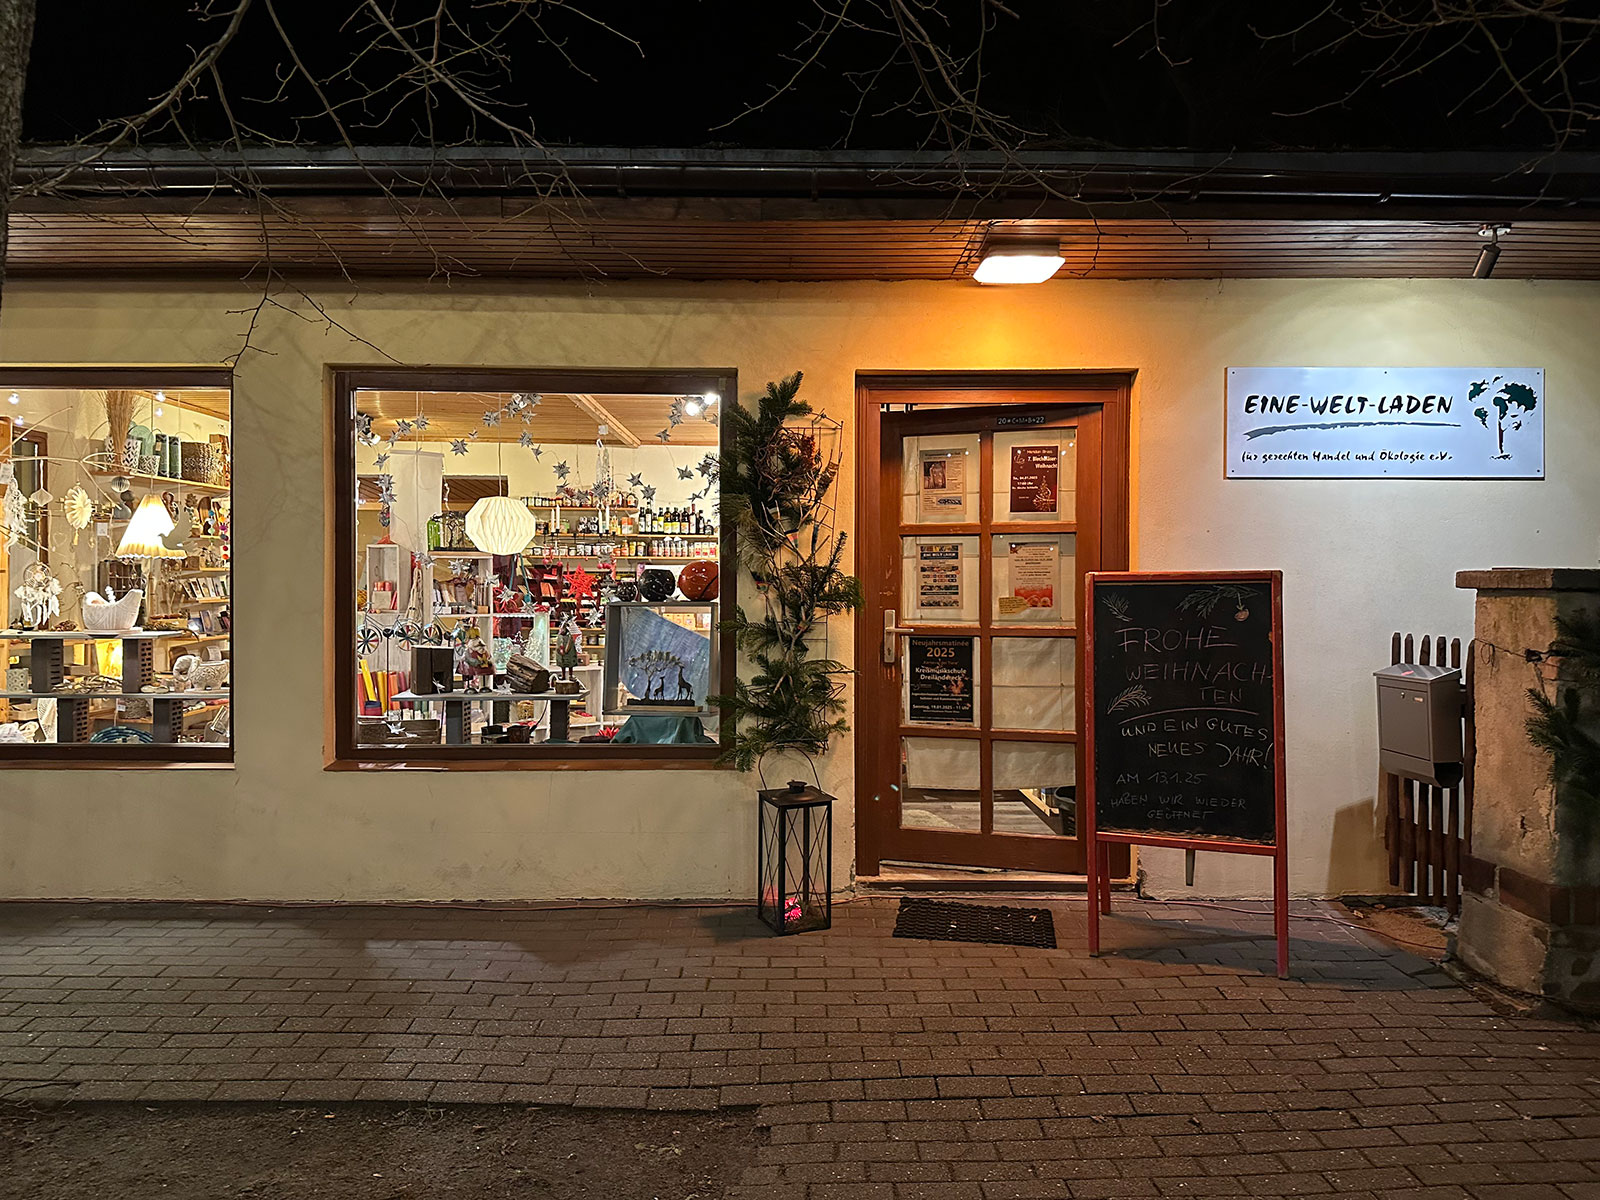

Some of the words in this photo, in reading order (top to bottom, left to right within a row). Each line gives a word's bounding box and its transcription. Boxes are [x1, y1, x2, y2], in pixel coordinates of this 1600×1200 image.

[1244, 395, 1453, 415] EINE-WELT-LADEN
[1242, 451, 1258, 462] für
[1262, 451, 1309, 463] gerechten
[1312, 450, 1351, 461] Handel
[1355, 451, 1375, 461] und
[1379, 448, 1425, 463] Ökologie
[1429, 451, 1453, 461] e.V.
[1115, 627, 1238, 653] FROHE
[926, 647, 955, 657] 2025
[1199, 687, 1243, 704] TEN
[1121, 721, 1158, 738] UND
[1163, 717, 1199, 733] EIN
[1206, 717, 1269, 741] GUTES
[1148, 742, 1209, 757] NEUES
[1216, 742, 1274, 770] JAHR!
[1115, 772, 1140, 784] AM
[1147, 771, 1209, 784] 13.1.25
[1111, 792, 1149, 808] HABEN
[1159, 795, 1184, 807] WIR
[1195, 796, 1247, 809] WIEDER
